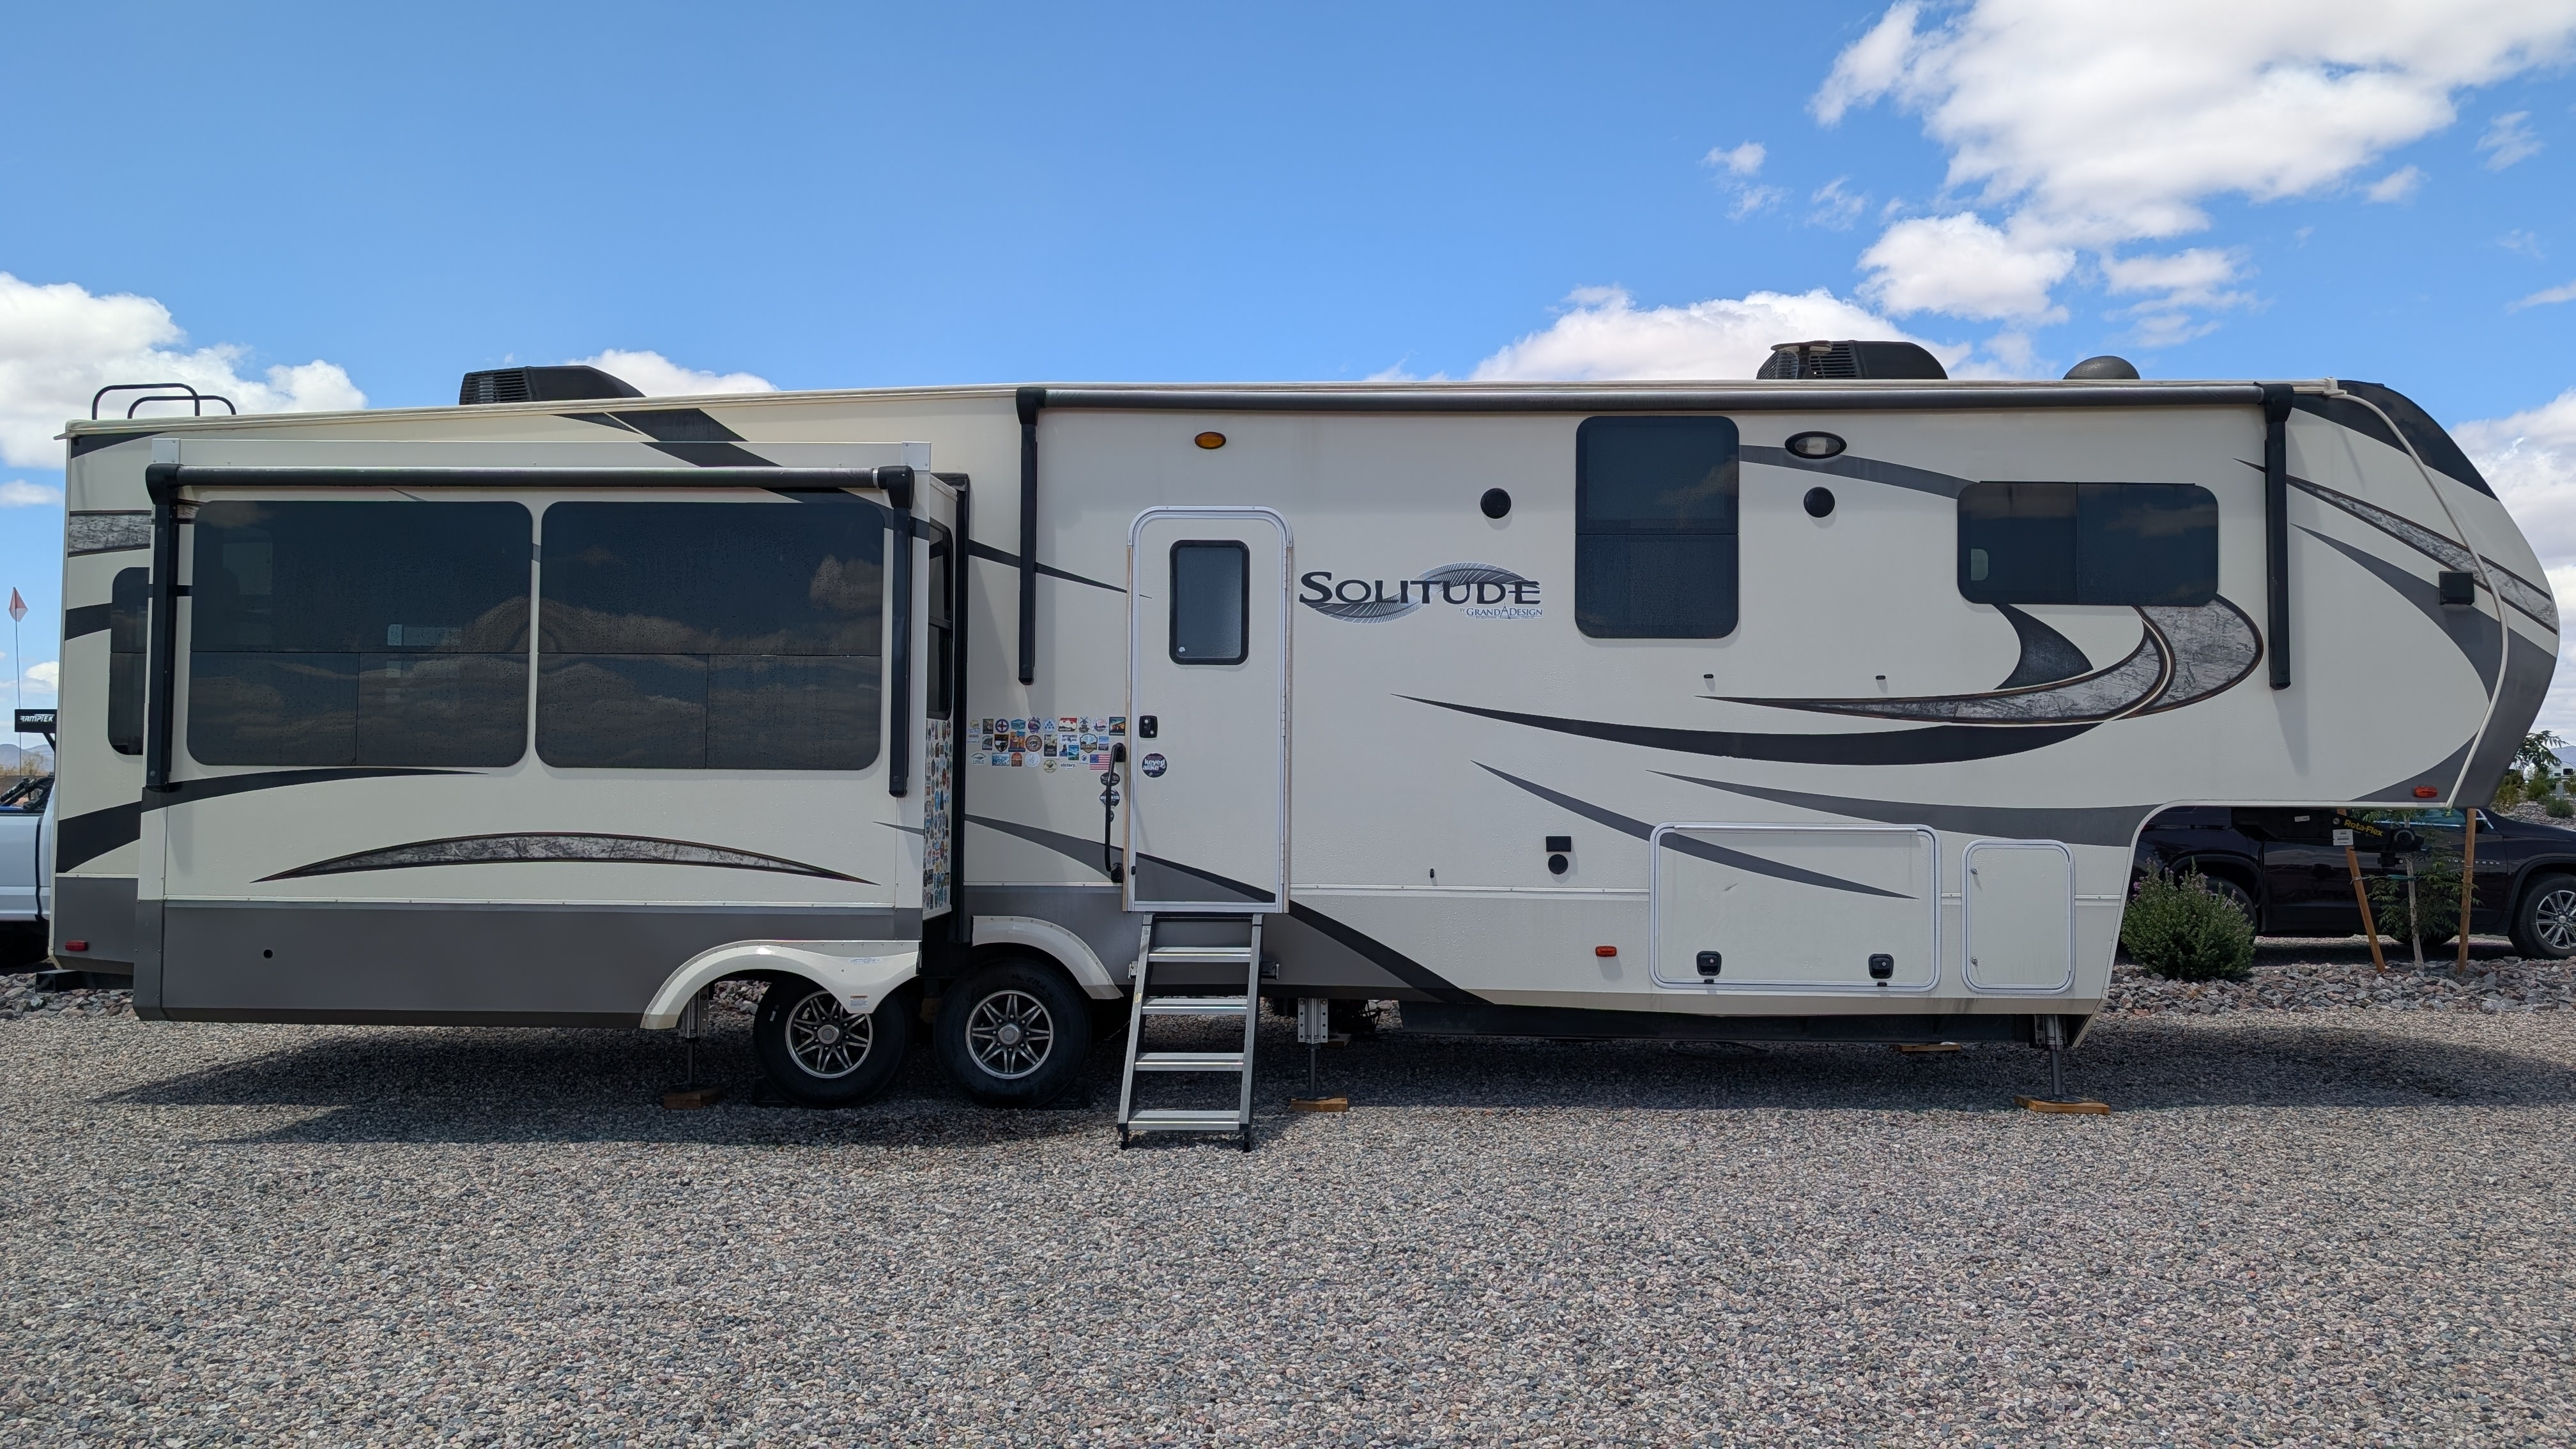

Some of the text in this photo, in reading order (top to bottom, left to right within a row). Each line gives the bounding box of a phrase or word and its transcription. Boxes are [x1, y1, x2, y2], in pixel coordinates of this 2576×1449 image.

[1298, 571, 1541, 604] SOLITUDE
[1509, 608, 1543, 616] DESIGN
[20, 714, 56, 723] RAMPTEK
[1144, 758, 1165, 766] keyed
[2343, 818, 2384, 837] Rota-Flex
